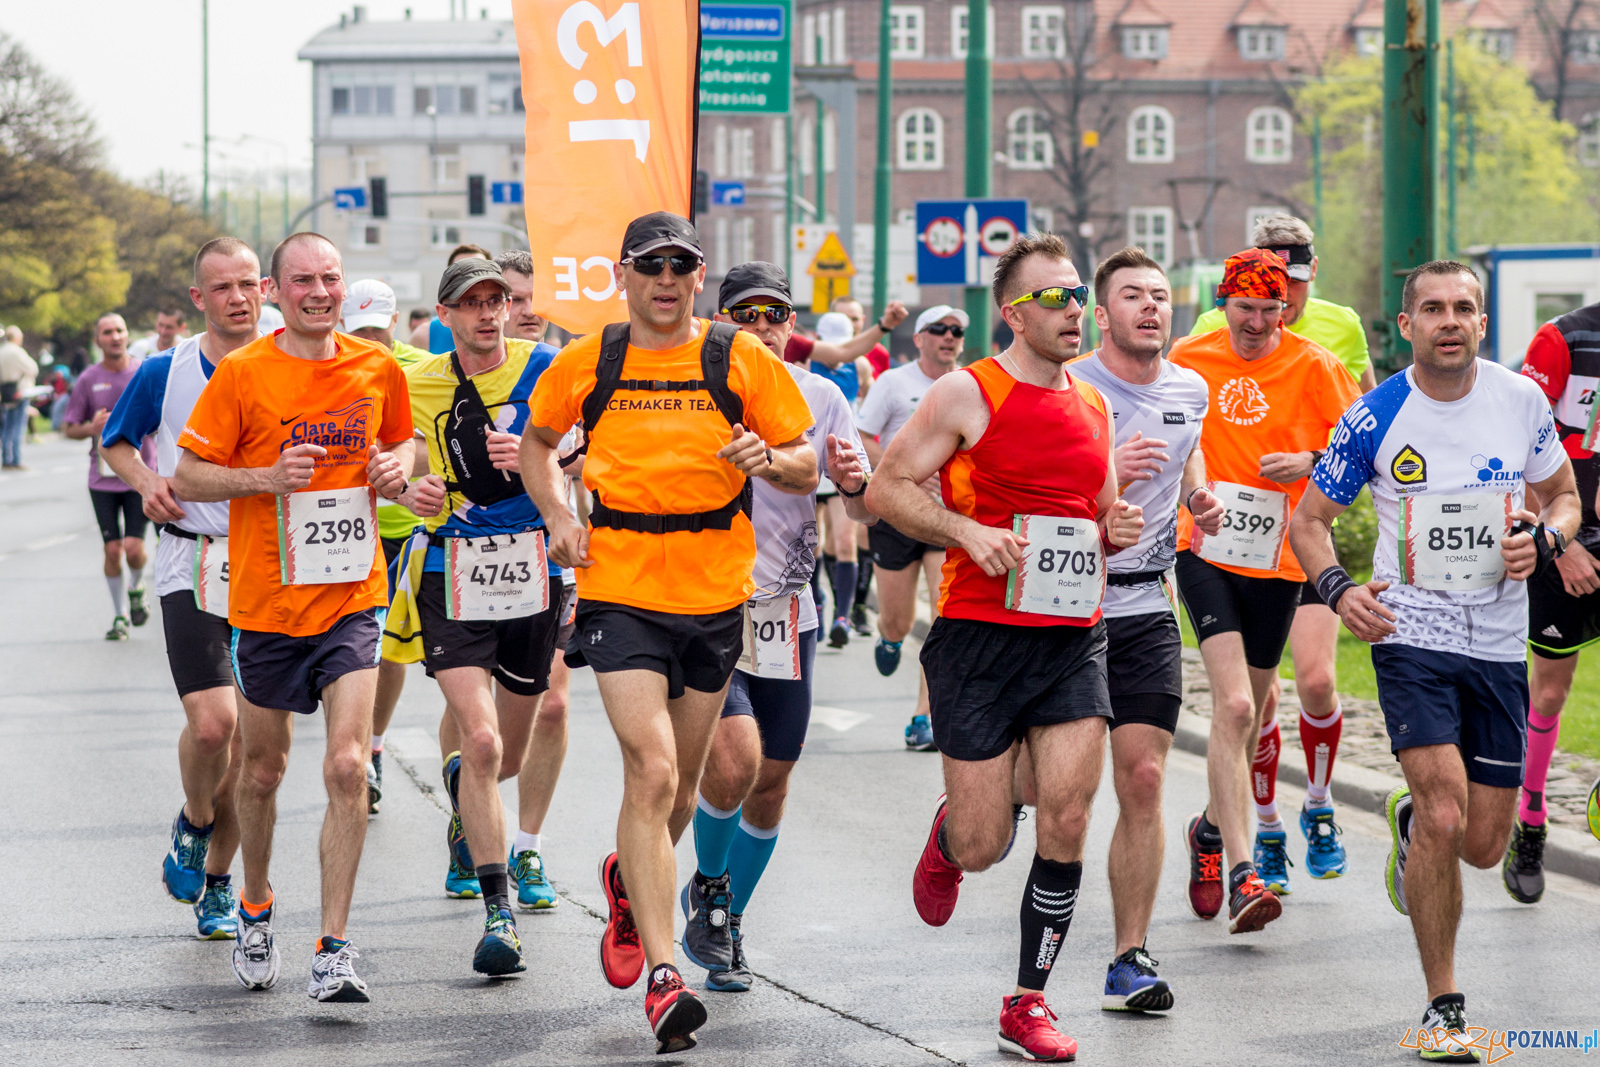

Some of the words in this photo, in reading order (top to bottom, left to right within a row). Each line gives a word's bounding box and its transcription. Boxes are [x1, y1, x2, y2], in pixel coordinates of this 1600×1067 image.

[700, 46, 778, 65] ydgoszcz
[700, 67, 771, 84] atowice
[603, 399, 682, 411] CEMAKER
[1343, 398, 1378, 434] IMP
[291, 421, 337, 441] Clare
[1234, 411, 1267, 426] BIEGA
[280, 429, 366, 455] Crusaders
[1331, 417, 1351, 450] OP
[1320, 446, 1348, 484] AM
[304, 517, 366, 545] 2398
[1232, 535, 1254, 544] Gerard
[1428, 525, 1495, 551] 8514
[470, 561, 531, 585] 4743
[1038, 548, 1096, 576] 8703
[481, 589, 523, 597] Przemysław
[1058, 580, 1081, 588] Robert
[1035, 926, 1054, 969] COMPRES
[1043, 940, 1059, 970] SPORT
